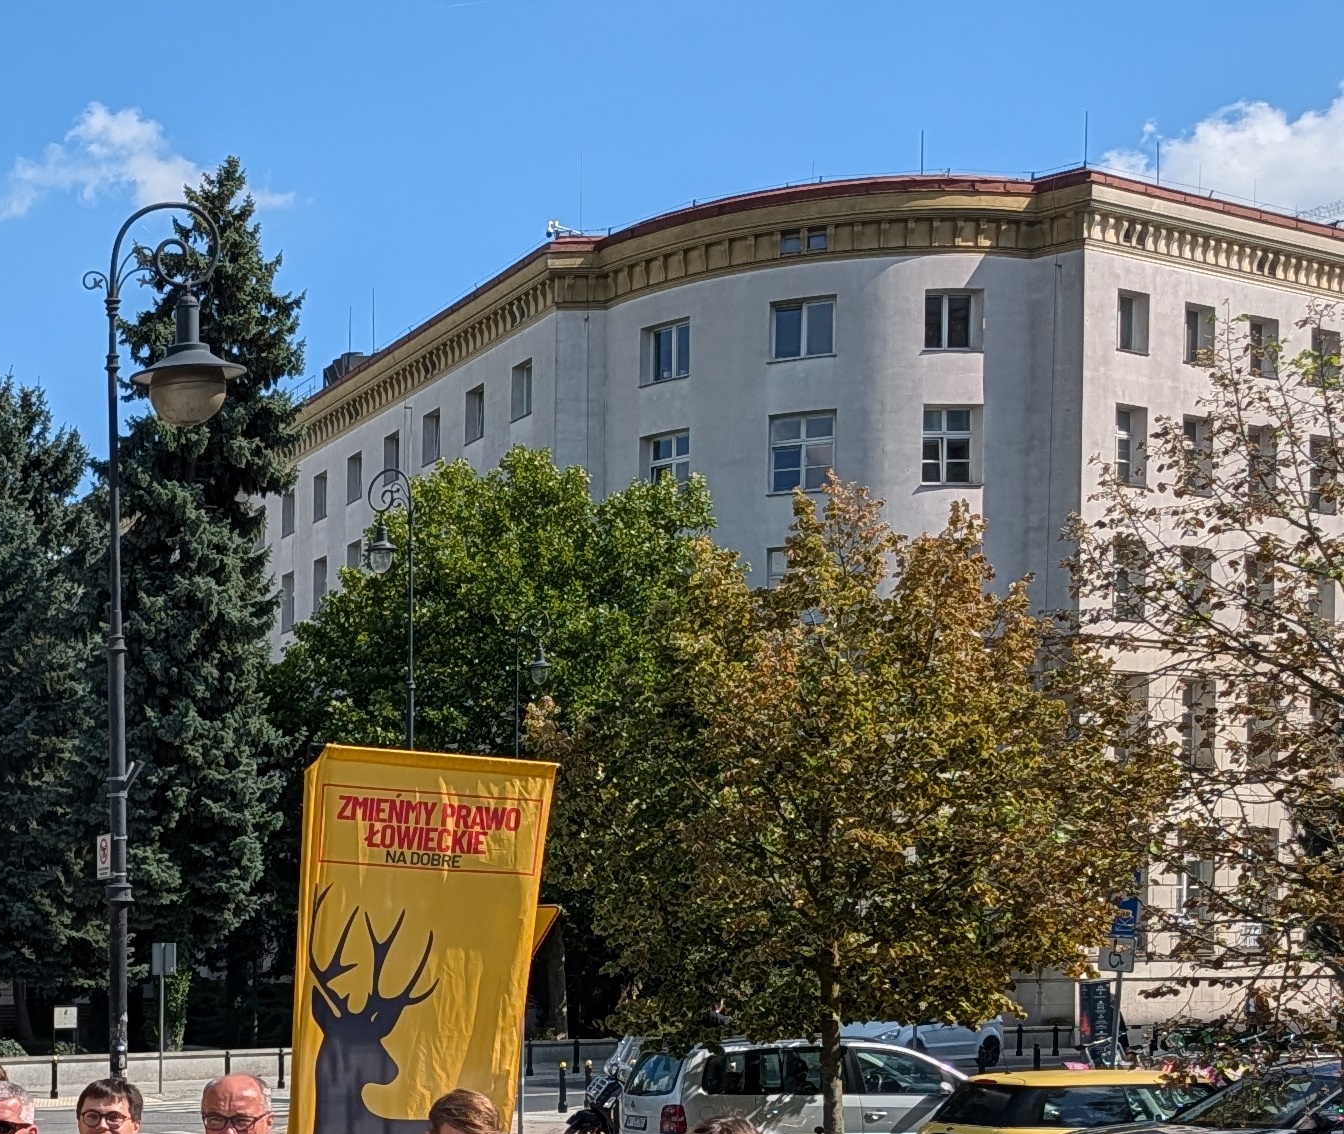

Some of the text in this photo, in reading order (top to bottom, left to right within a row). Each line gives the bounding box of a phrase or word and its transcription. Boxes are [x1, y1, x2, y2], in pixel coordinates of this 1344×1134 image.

[337, 794, 521, 831] ZMIEŃMY PRAWO
[364, 823, 489, 855] ŁOWIECKIE
[385, 850, 462, 868] NA DOBRE
